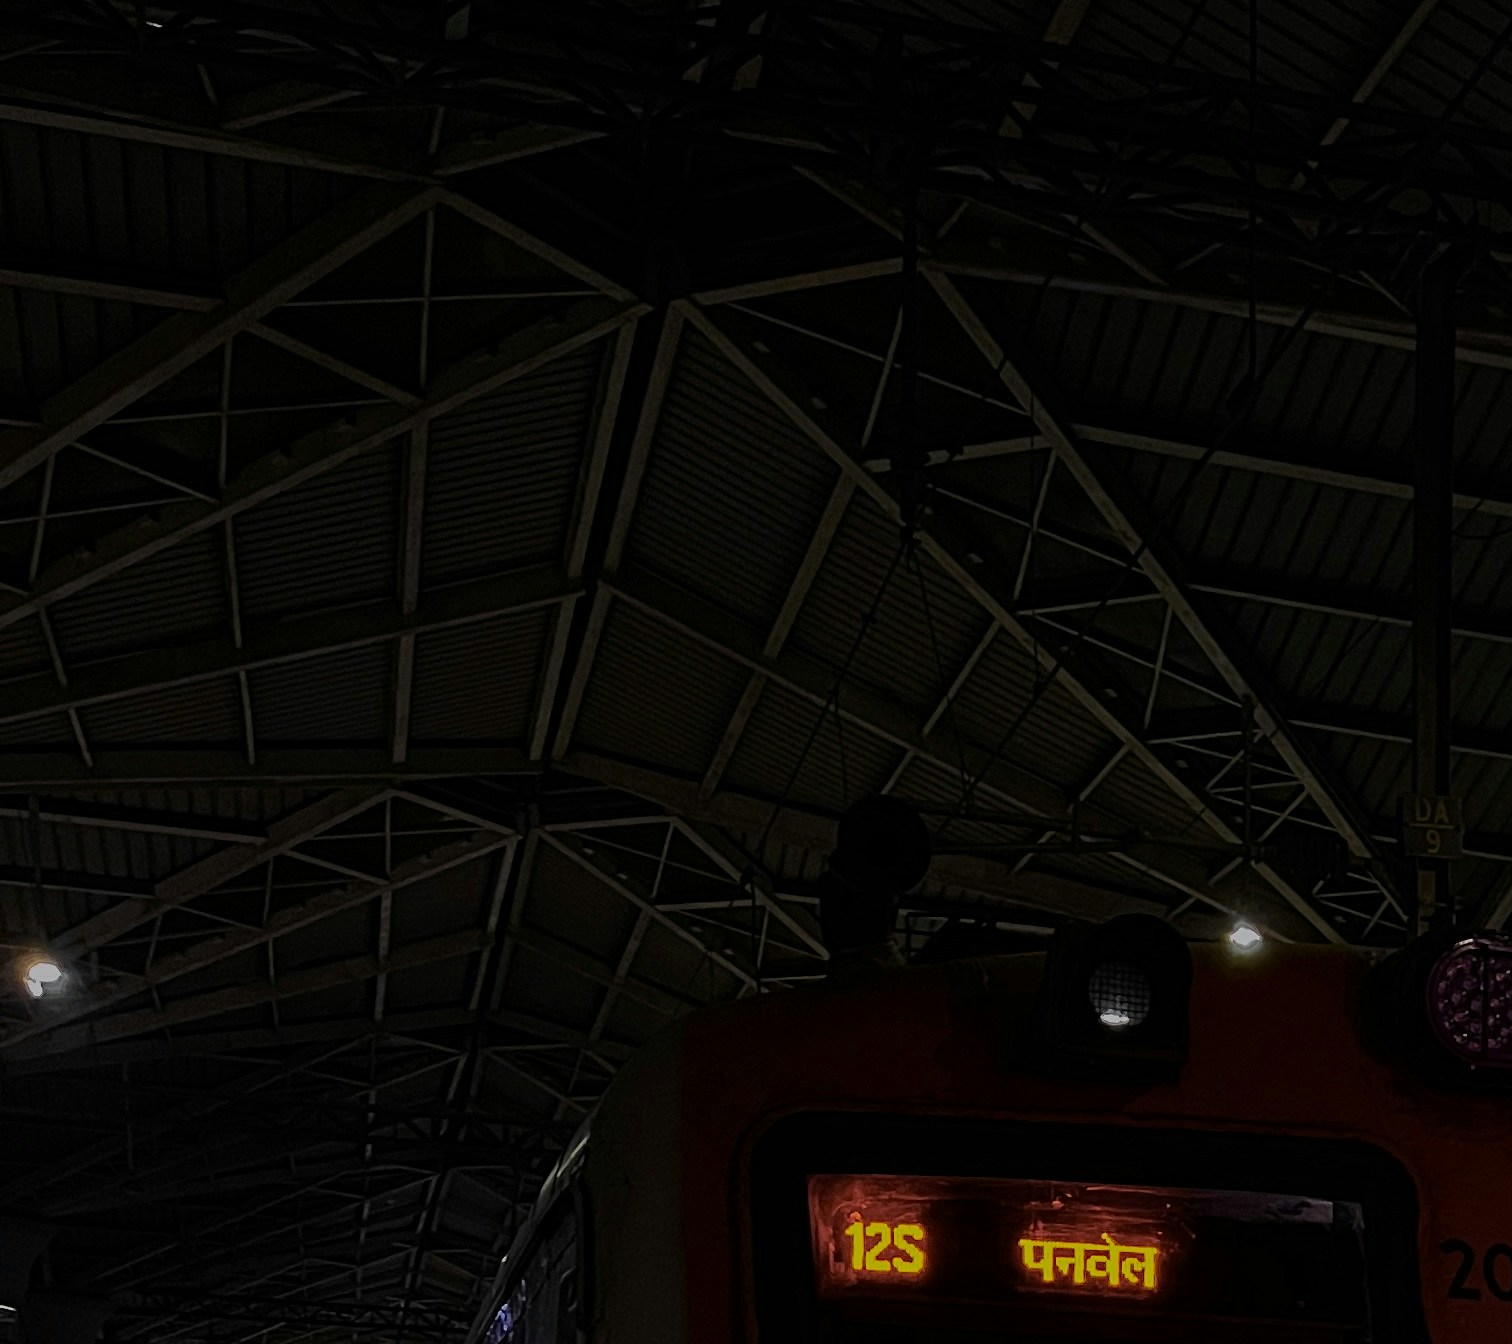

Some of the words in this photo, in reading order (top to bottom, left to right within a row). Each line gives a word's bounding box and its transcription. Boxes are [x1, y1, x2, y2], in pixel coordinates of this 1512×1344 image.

[1413, 796, 1451, 825] DA
[1425, 829, 1441, 854] 9
[845, 1221, 926, 1273] 12S
[1017, 1232, 1158, 1289] पनवेल
